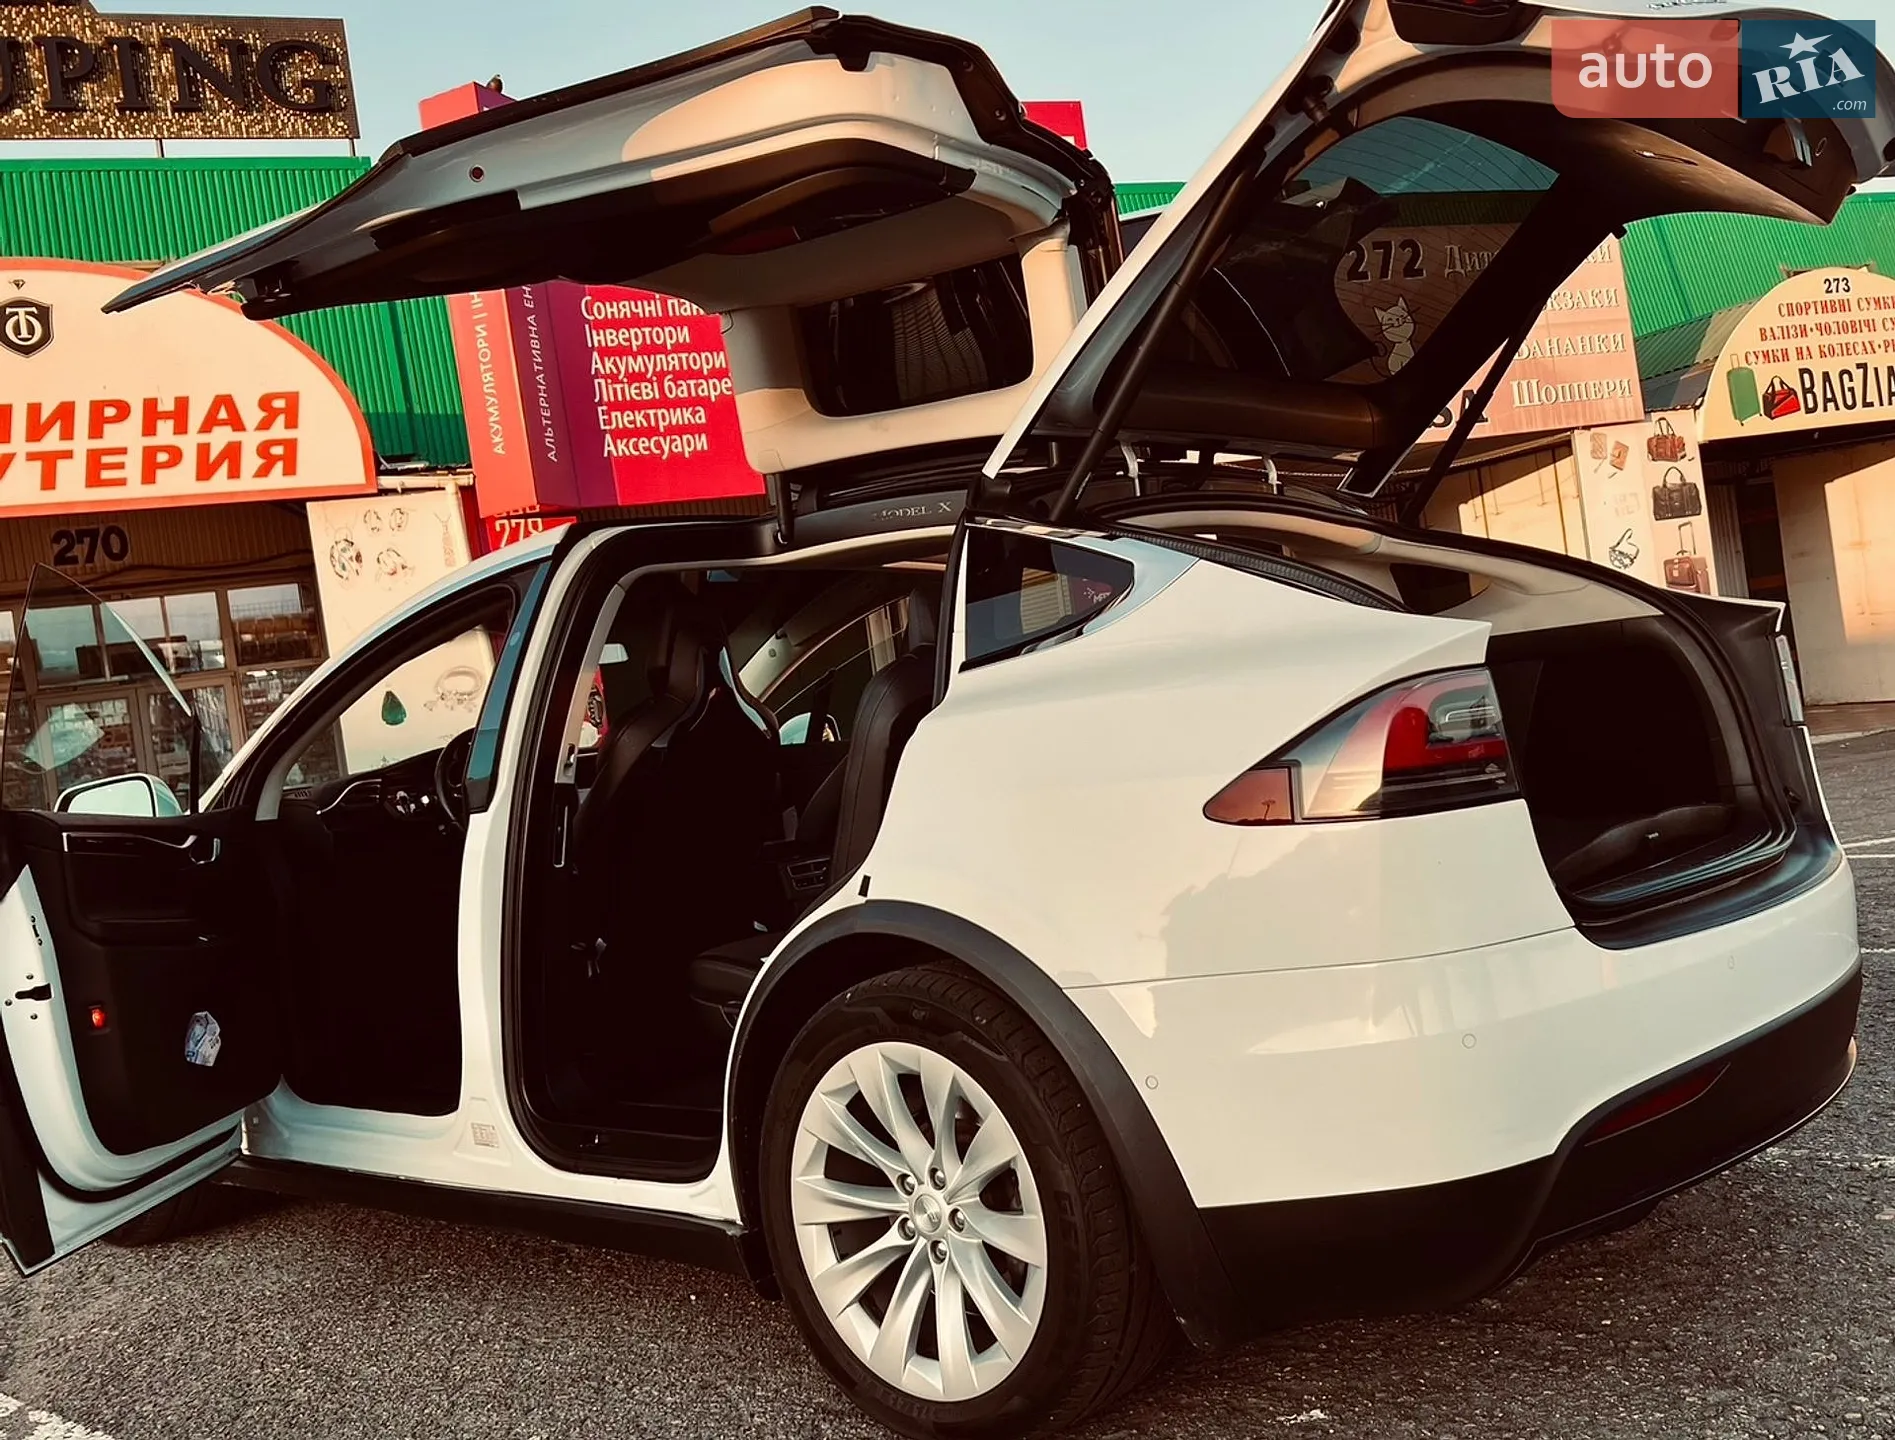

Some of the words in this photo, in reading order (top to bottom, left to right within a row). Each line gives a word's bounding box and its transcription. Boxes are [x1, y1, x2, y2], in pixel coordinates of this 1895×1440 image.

[1346, 238, 1427, 282] 272
[521, 283, 535, 308] ЕН
[1823, 277, 1851, 294] 273
[581, 294, 664, 321] Сонячні
[1542, 288, 1620, 312] КЗАКИ
[1777, 298, 1852, 318] СПОРТИВНІ
[584, 323, 691, 352] Інвертори
[591, 350, 727, 380] Акумулятори
[1744, 347, 1790, 366] СУМКИ
[1796, 346, 1813, 362] НА
[474, 323, 506, 455] АКУМУЛЯТОРИ
[526, 314, 558, 463] АЛЬТЕРНАТИВНА
[594, 376, 661, 403] Літієві
[663, 373, 733, 402] батаре
[597, 405, 707, 433] Електрика
[603, 433, 709, 460] Аксесуари
[938, 501, 952, 513] X
[51, 524, 131, 567] 270
